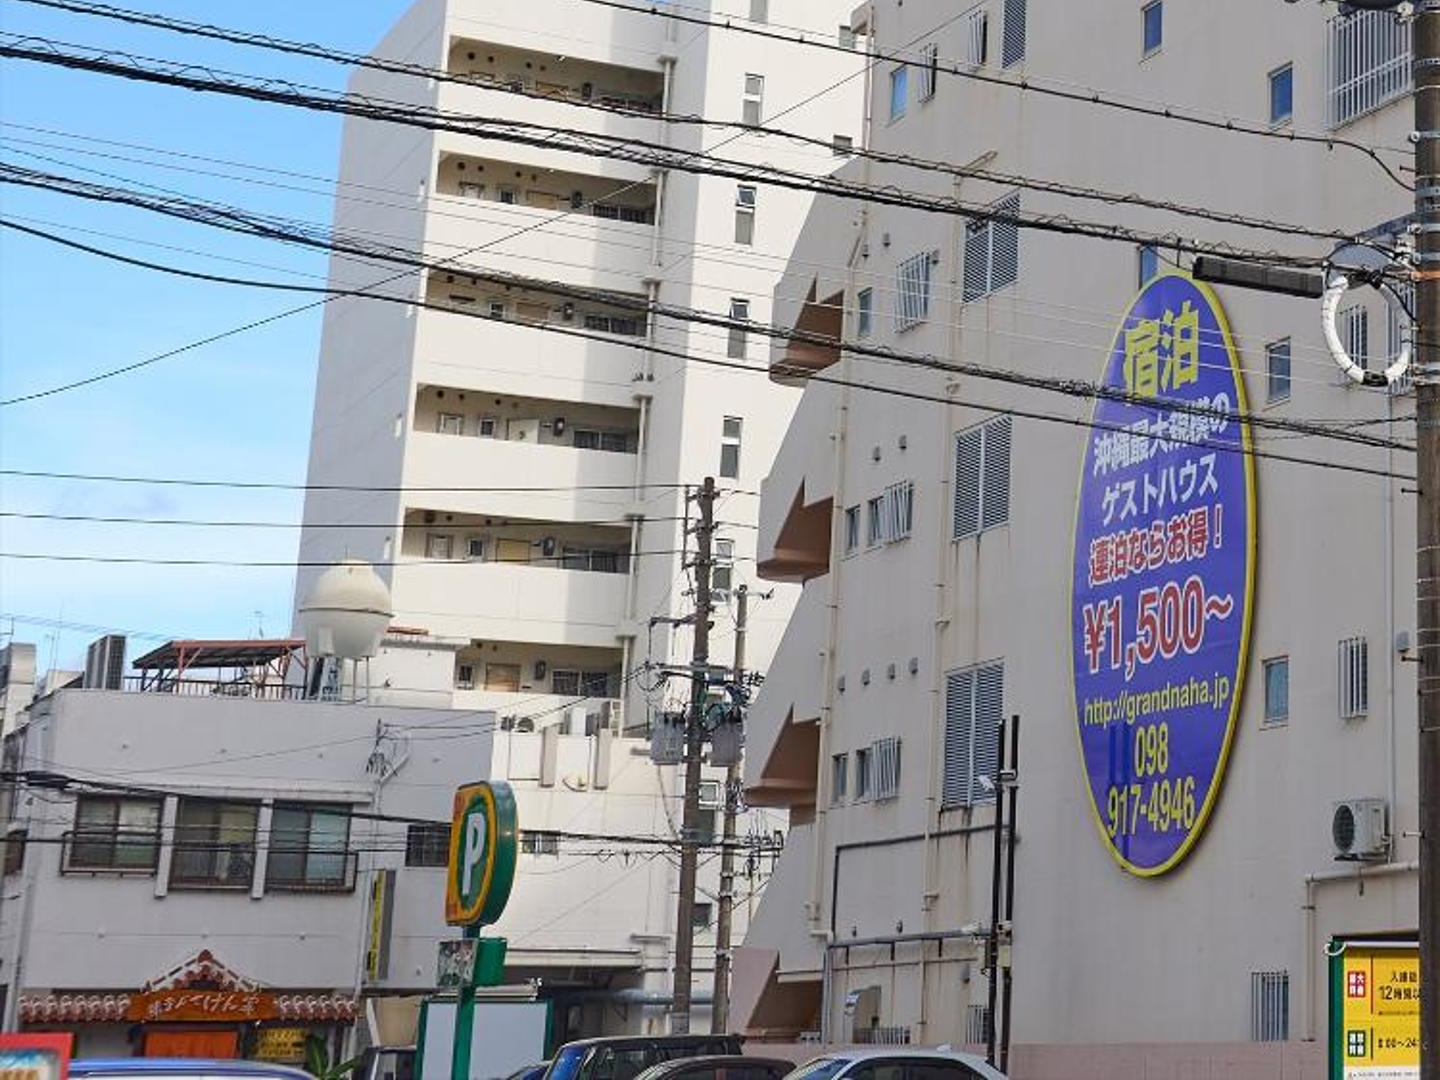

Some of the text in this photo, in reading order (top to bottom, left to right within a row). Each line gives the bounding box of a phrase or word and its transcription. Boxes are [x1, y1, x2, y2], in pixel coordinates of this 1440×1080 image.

[1123, 299, 1199, 407] 宿泊
[1094, 391, 1231, 478] 沖縄最大規模の
[1102, 453, 1219, 526] ゲストハウス
[1089, 503, 1223, 589] 連泊ならお得！
[1084, 671, 1230, 729] http://grandnaha.jp
[1134, 721, 1169, 778] 098
[1107, 775, 1196, 839] 917-4946
[461, 812, 487, 896] P
